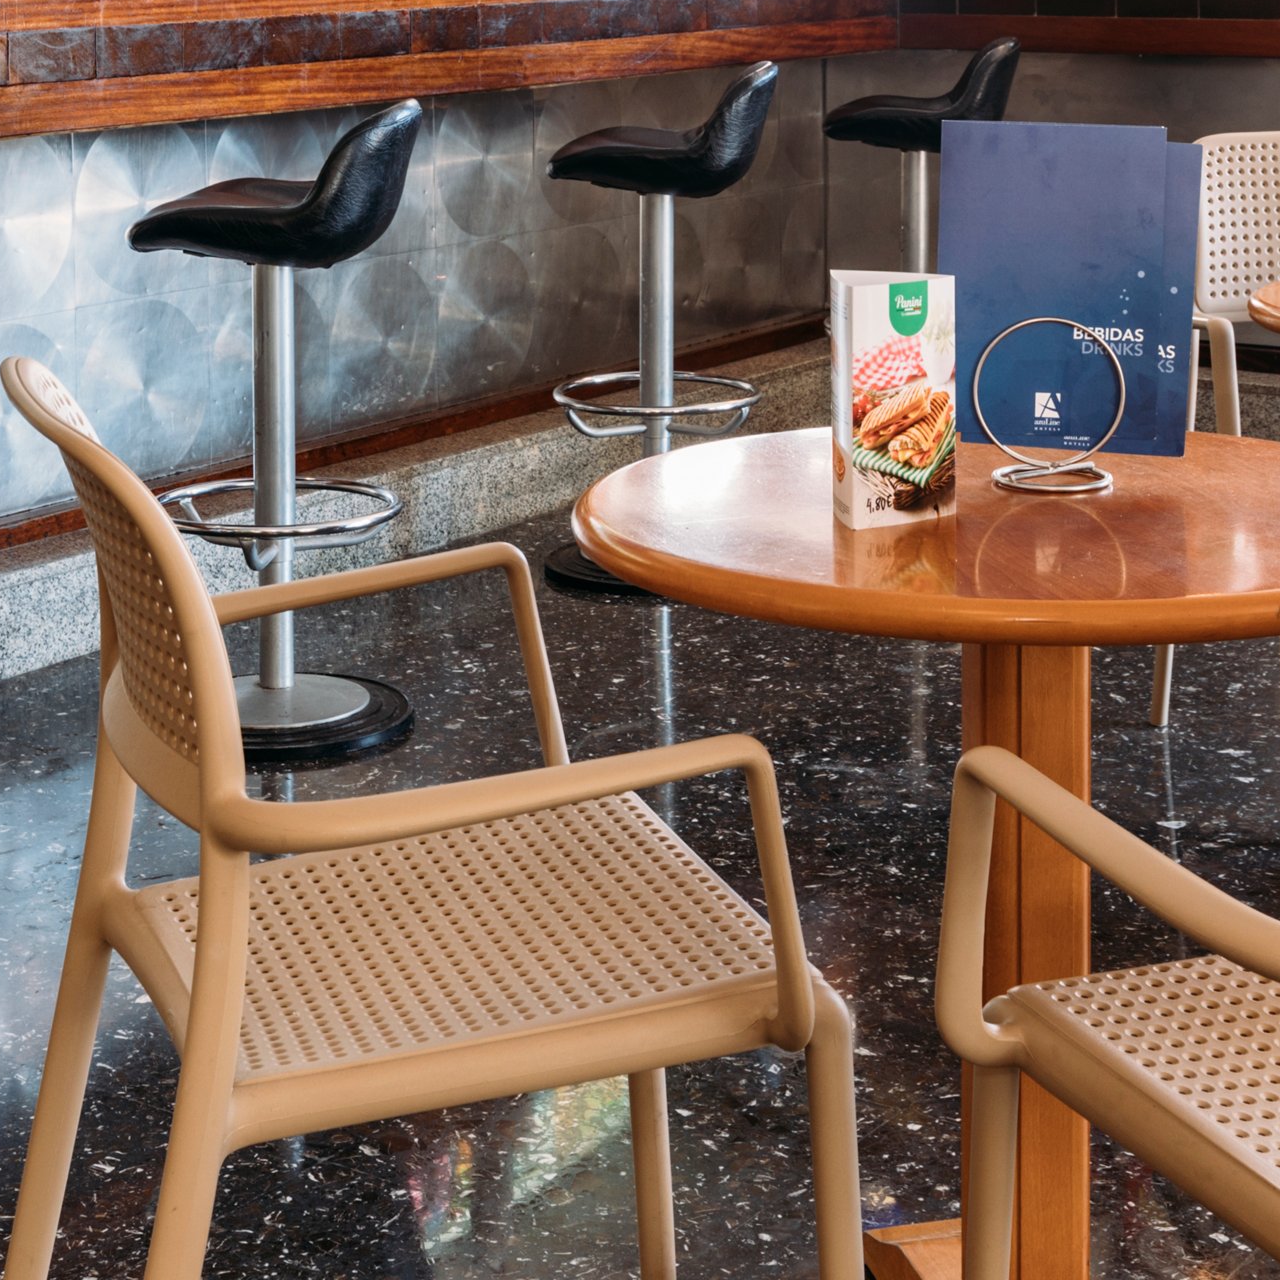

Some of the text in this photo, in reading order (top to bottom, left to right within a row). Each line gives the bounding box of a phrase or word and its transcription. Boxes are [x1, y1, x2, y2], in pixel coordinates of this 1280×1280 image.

[894, 294, 923, 309] Panini
[1073, 326, 1144, 342] BEBIDAS
[1081, 341, 1144, 357] DRNKS
